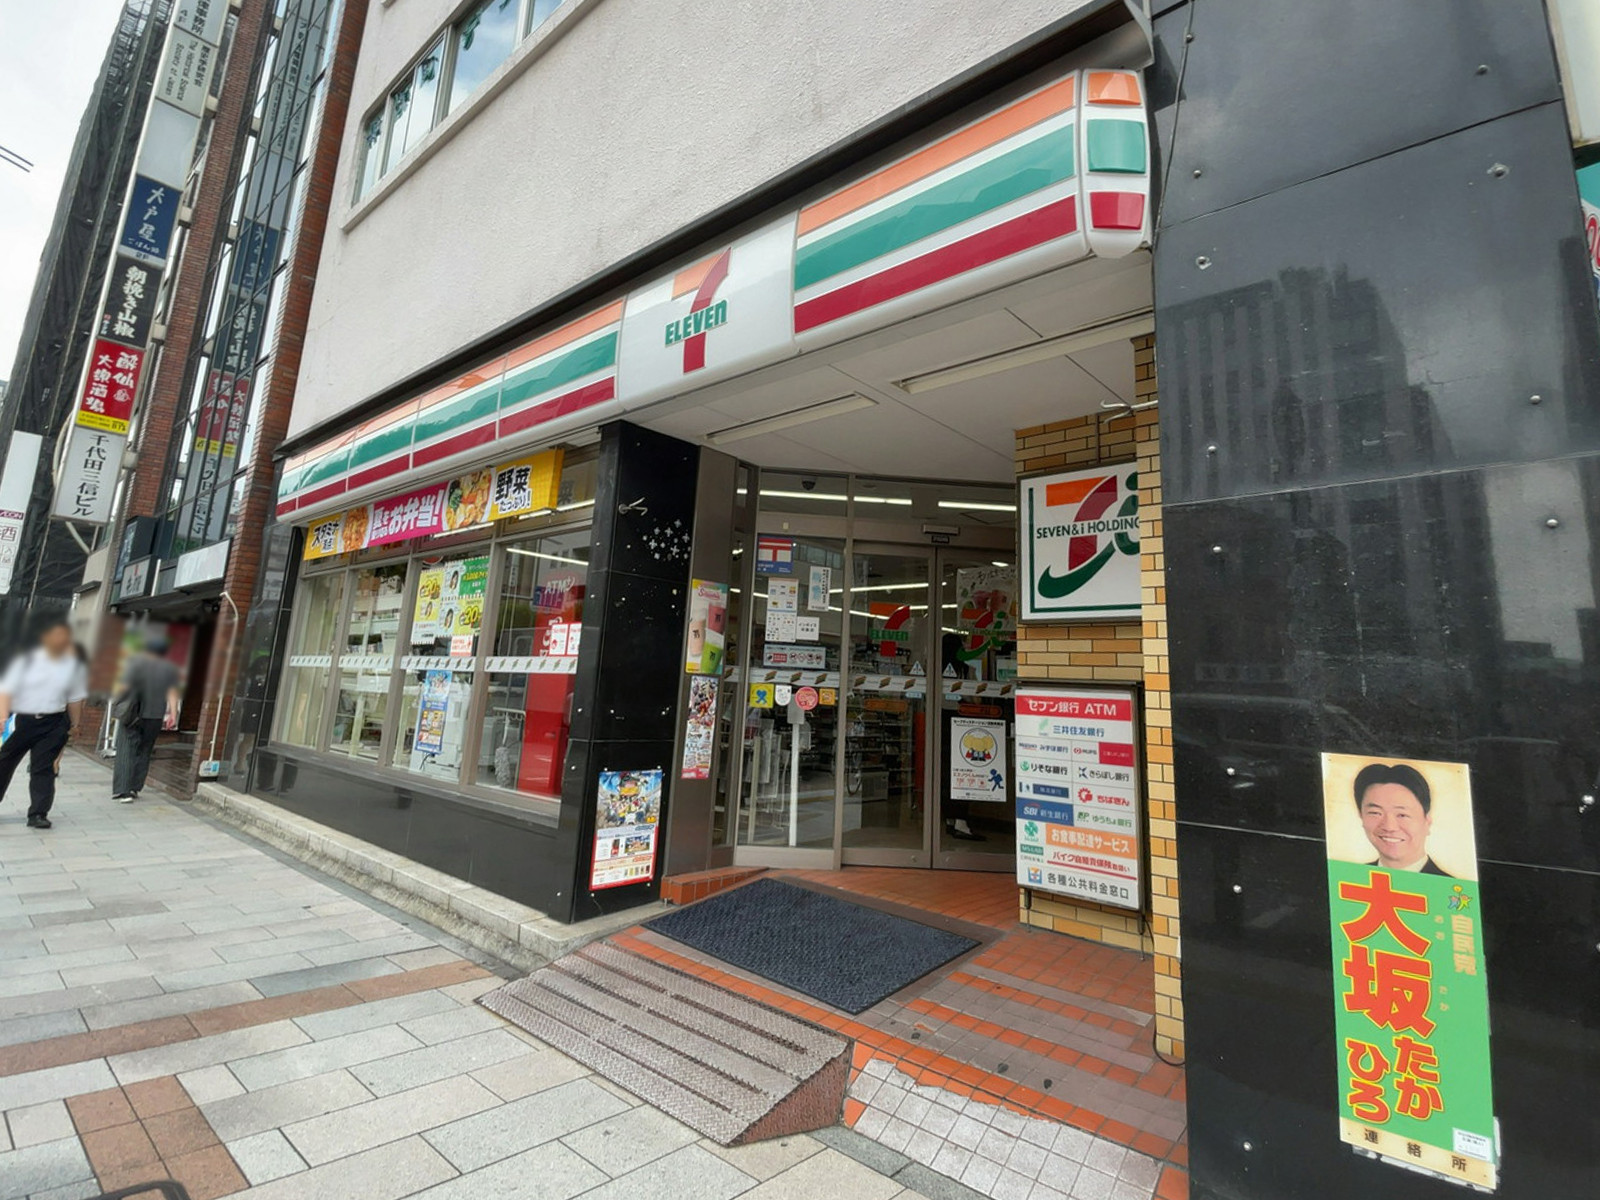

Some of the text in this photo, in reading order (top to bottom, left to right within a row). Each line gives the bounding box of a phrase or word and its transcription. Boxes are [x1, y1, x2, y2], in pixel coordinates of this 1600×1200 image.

[138, 187, 166, 243] 大戸屋
[72, 433, 110, 516] 千代田三信ビル
[496, 467, 531, 502] 野菜
[1028, 699, 1116, 716] セブン銀行 ATM
[1053, 725, 1105, 738] 三井住友銀行
[1031, 763, 1068, 775] りそな銀行
[1089, 770, 1130, 782] きらぼし銀行
[1023, 806, 1038, 815] SBI
[1040, 809, 1069, 821] 新生銀行
[1092, 815, 1132, 828] ゆうちょ銀行
[1047, 872, 1129, 900] 各種公共料金窓口
[1338, 869, 1438, 1040] 大坂
[1451, 914, 1478, 976] 自民党
[1345, 1037, 1391, 1124] ひろ
[1392, 1035, 1444, 1120] たか
[1364, 1128, 1467, 1172] 連絡所
